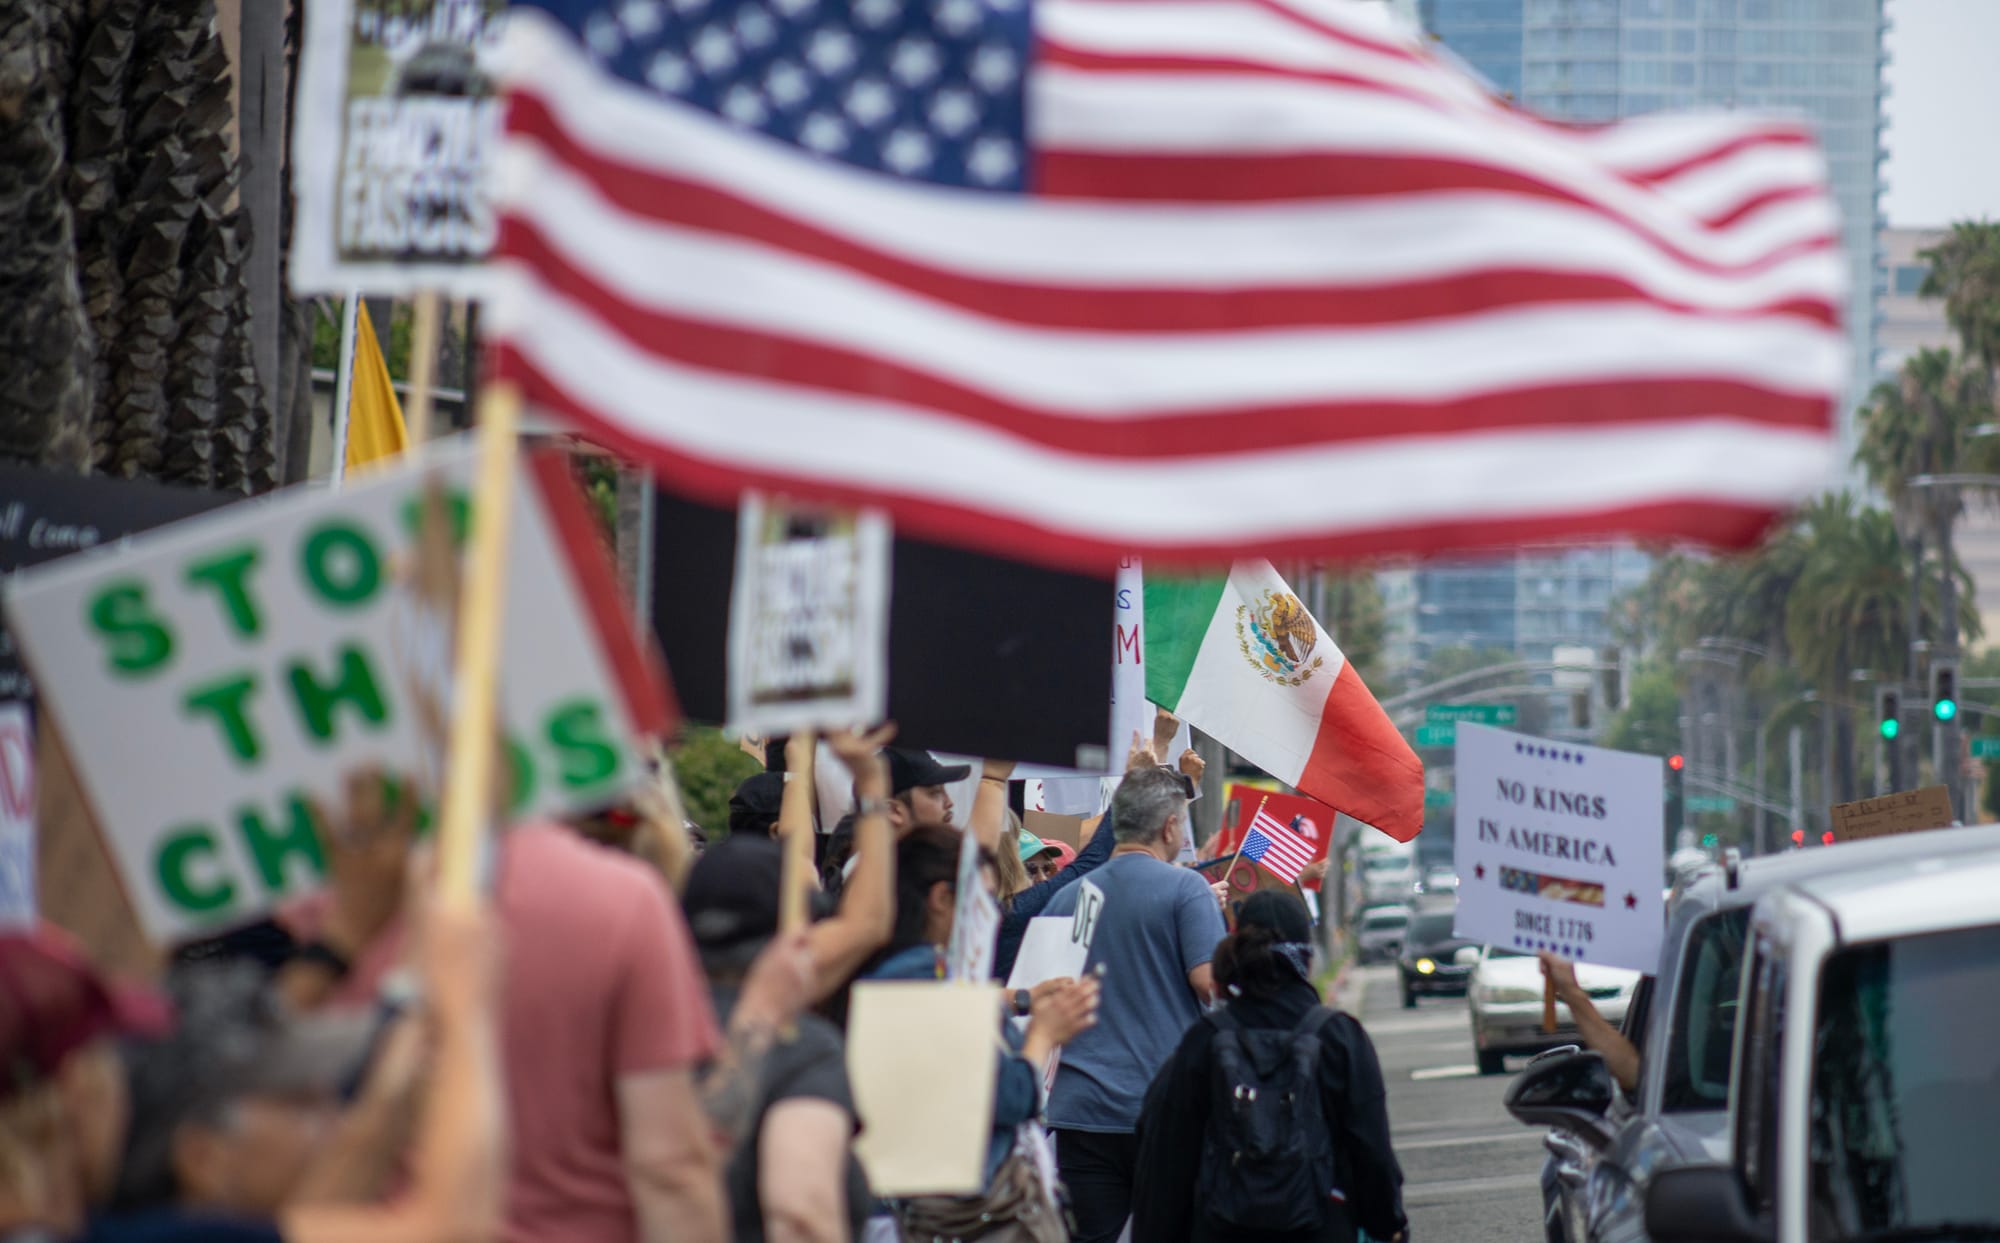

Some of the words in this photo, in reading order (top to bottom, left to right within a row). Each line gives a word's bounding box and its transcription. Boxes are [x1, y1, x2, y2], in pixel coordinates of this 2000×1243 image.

[1497, 777, 1526, 806] NO
[1533, 785, 1608, 821] KINGS
[1477, 816, 1500, 844] IN
[1504, 826, 1617, 868] AMERICA
[1513, 908, 1551, 938] SINCE
[1557, 916, 1595, 944] 1776
